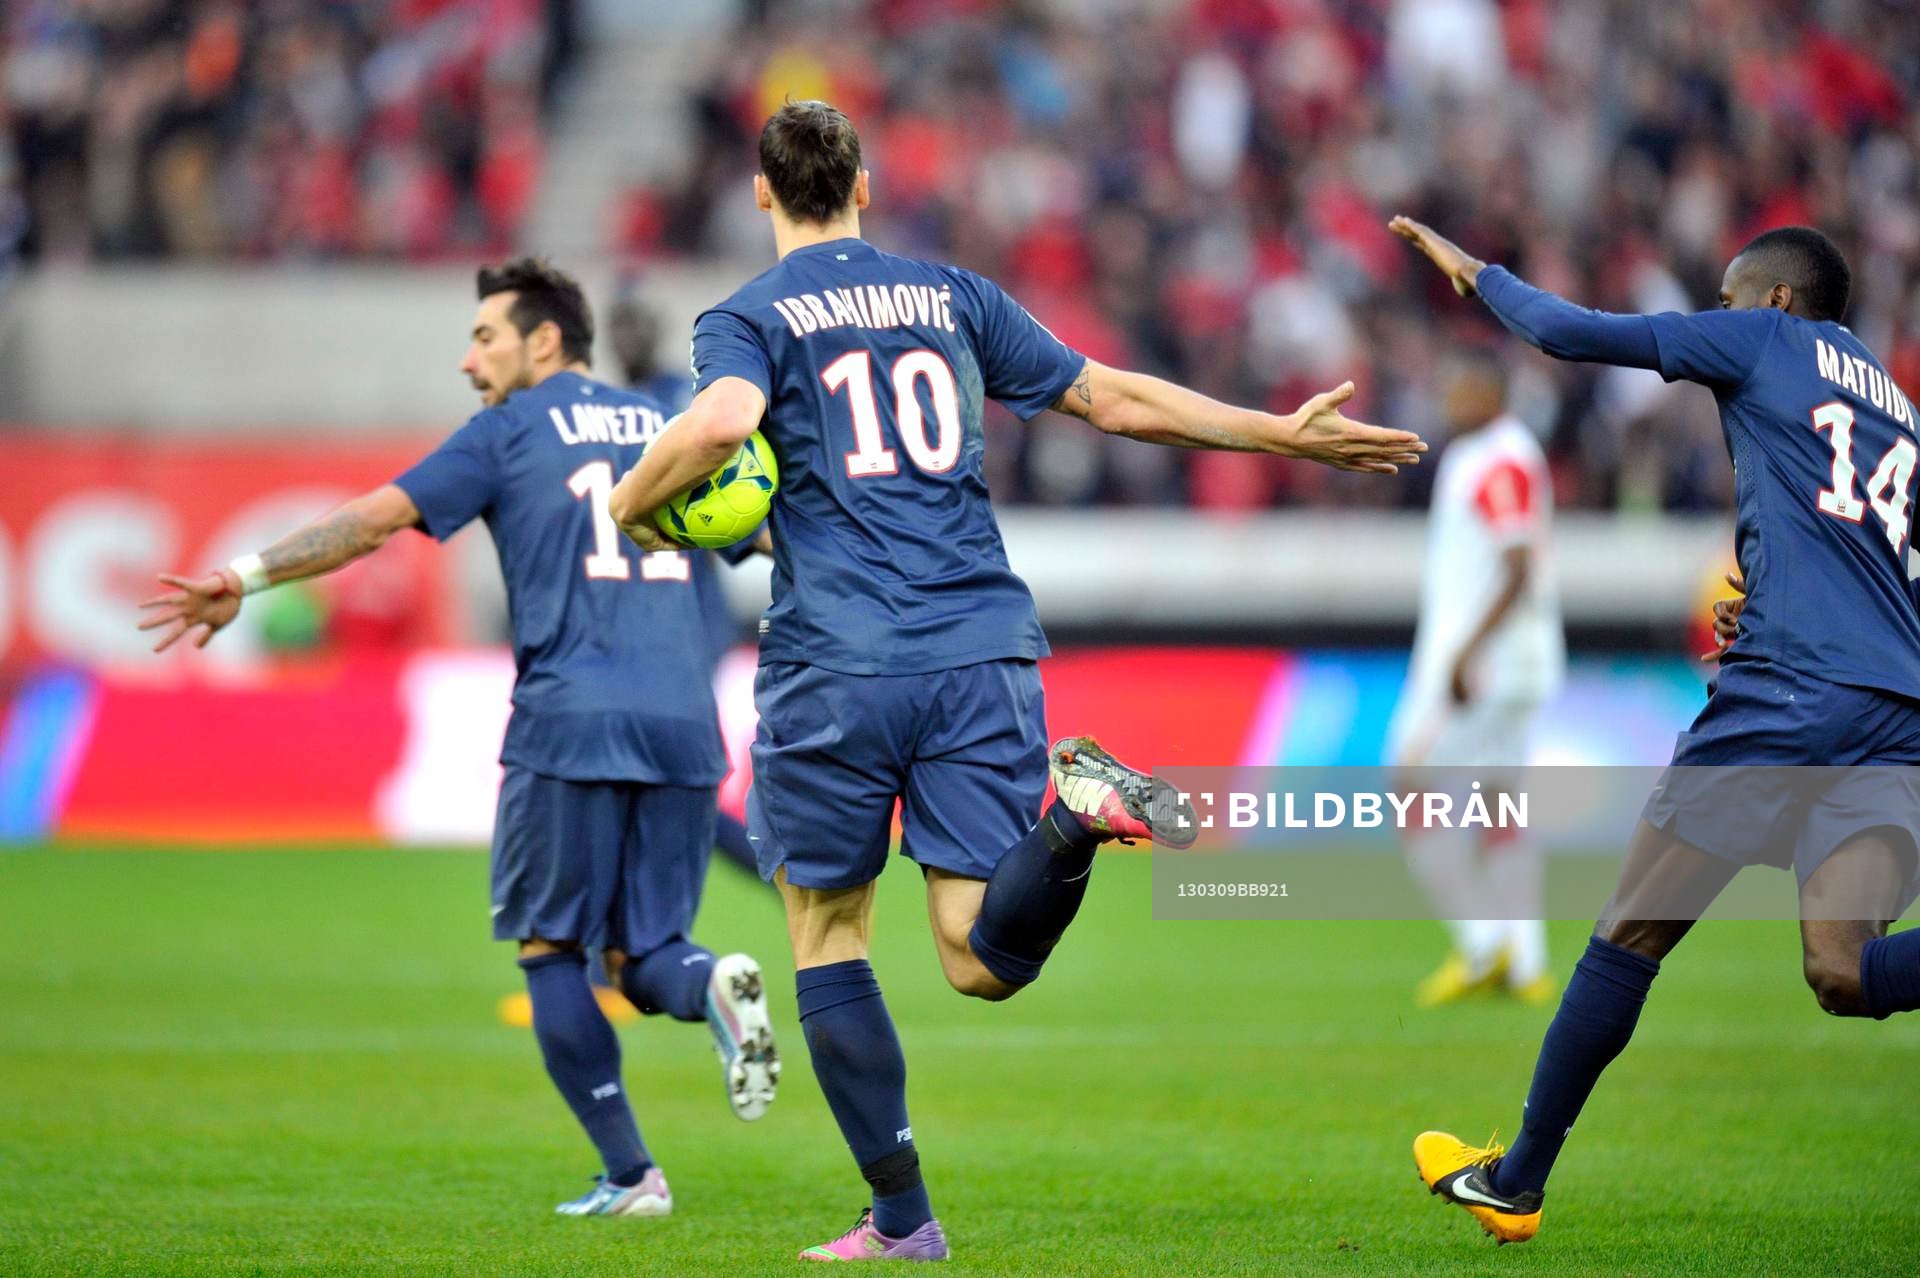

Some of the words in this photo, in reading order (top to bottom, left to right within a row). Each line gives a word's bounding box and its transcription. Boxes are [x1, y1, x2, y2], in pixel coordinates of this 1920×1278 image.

[772, 284, 956, 338] IBRAHIMOVIĆ
[820, 348, 963, 479] 10
[1815, 337, 1916, 433] MATUIDI
[566, 459, 691, 582] 1
[1810, 401, 1918, 556] 14
